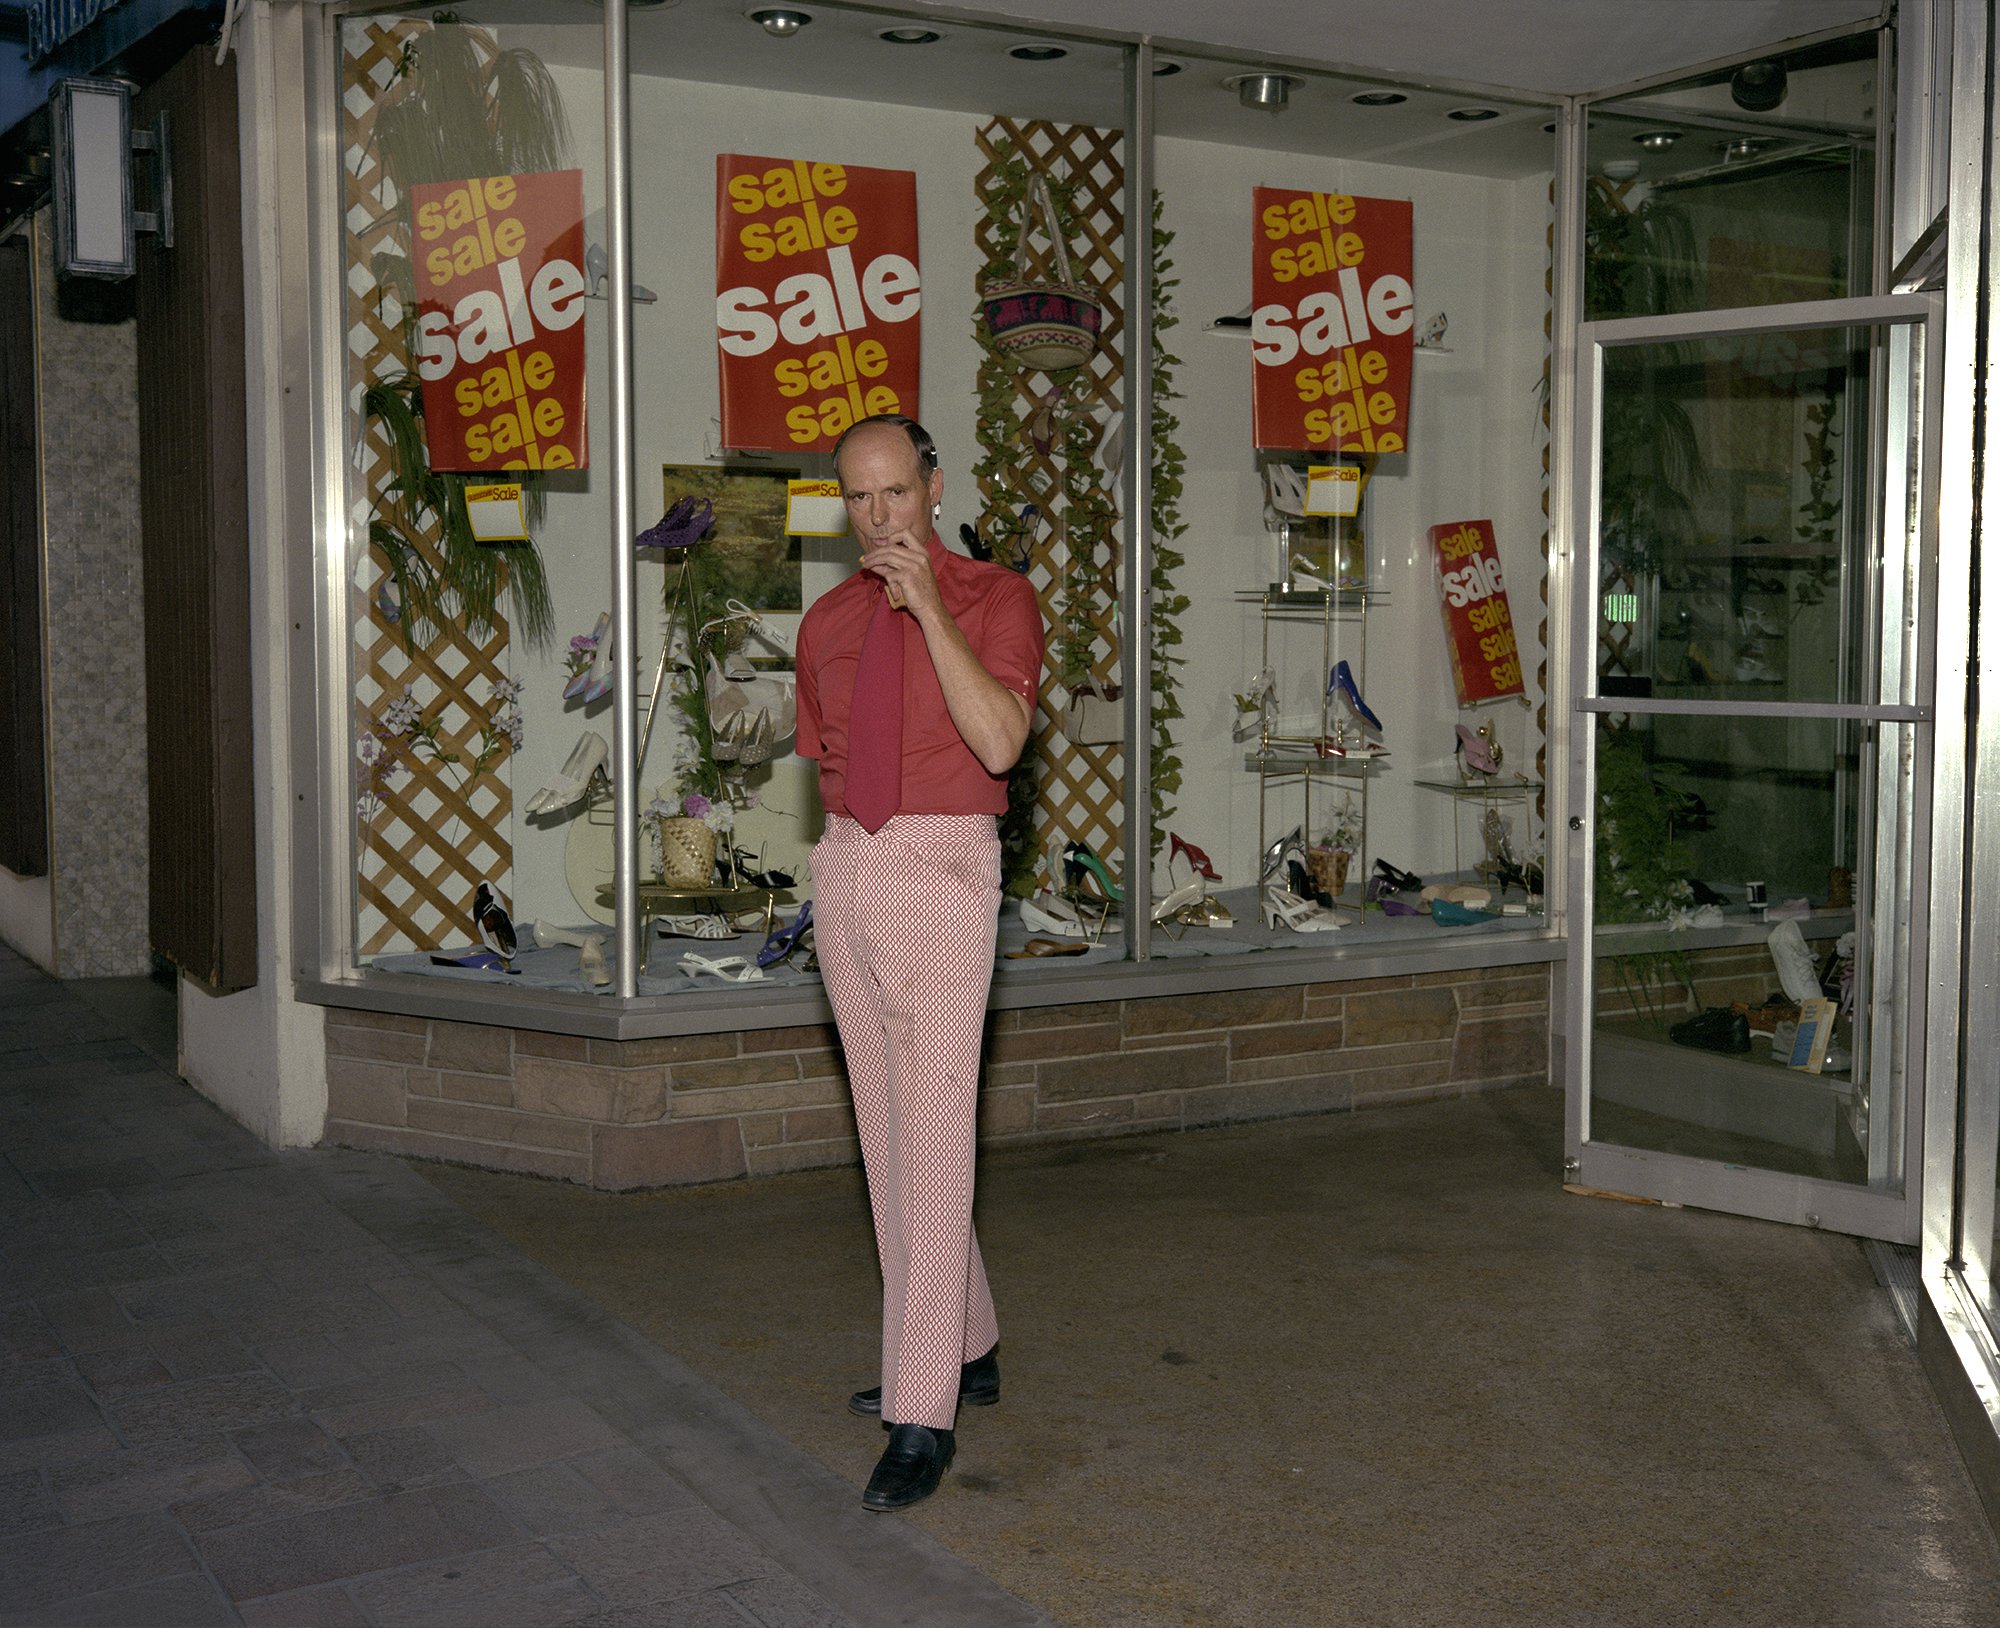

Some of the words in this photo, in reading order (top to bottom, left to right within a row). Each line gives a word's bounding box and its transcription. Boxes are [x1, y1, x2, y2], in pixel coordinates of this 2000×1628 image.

[417, 176, 518, 241] sale
[728, 160, 848, 214] sale
[1262, 191, 1356, 240] sale
[426, 217, 527, 286] sale
[740, 200, 859, 263] sale
[1270, 227, 1365, 283] sale
[413, 256, 585, 382] sale
[716, 244, 921, 357] sale
[1251, 266, 1414, 367] sale
[455, 349, 556, 417] sale
[774, 334, 889, 398] sale
[1295, 346, 1389, 402] sale
[464, 395, 565, 463] sale
[785, 381, 900, 444] sale
[1303, 387, 1397, 444] sale
[492, 487, 519, 501] Sale
[1334, 469, 1358, 481] Sale
[1439, 523, 1484, 561] sale
[1443, 551, 1506, 608] sale
[1467, 596, 1510, 633] sale
